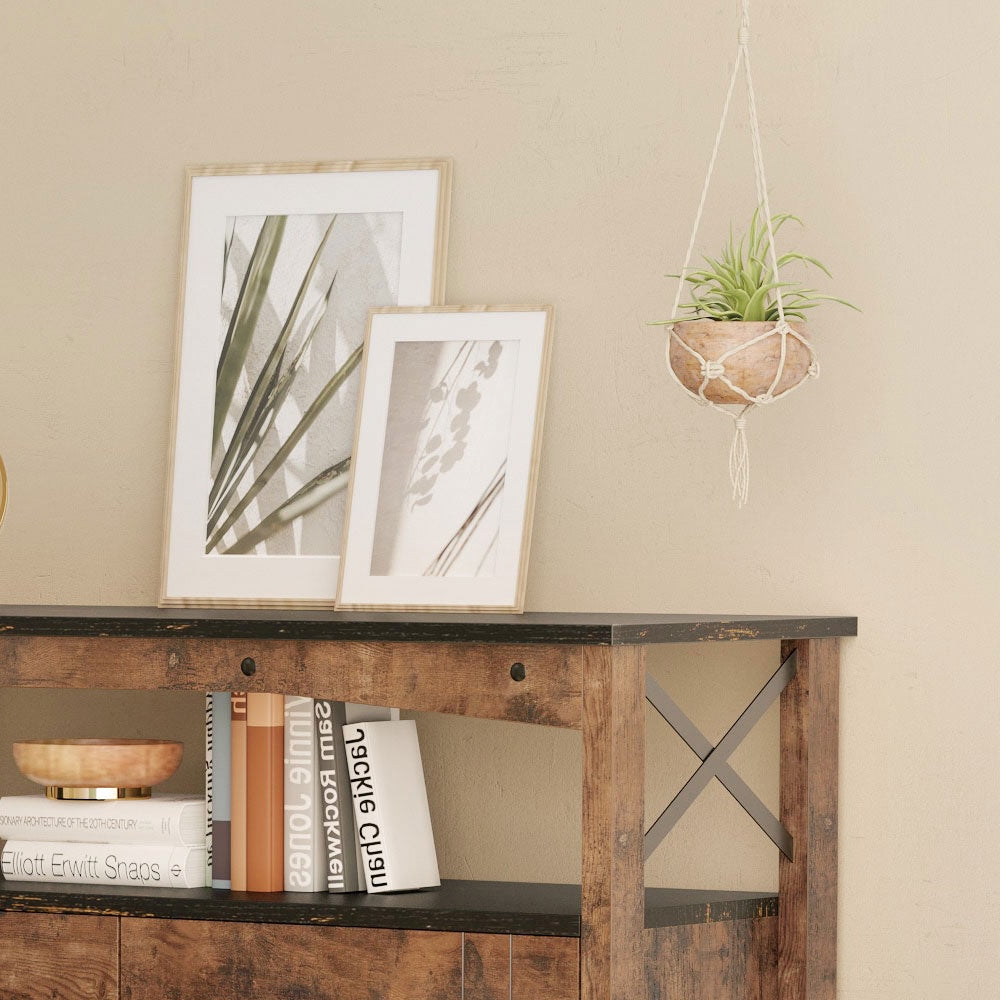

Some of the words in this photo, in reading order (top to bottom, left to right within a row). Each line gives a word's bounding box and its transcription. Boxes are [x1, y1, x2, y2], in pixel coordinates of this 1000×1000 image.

[1, 851, 46, 877] Elliott
[51, 853, 100, 879] Erwitt
[104, 854, 161, 885] Snaps
